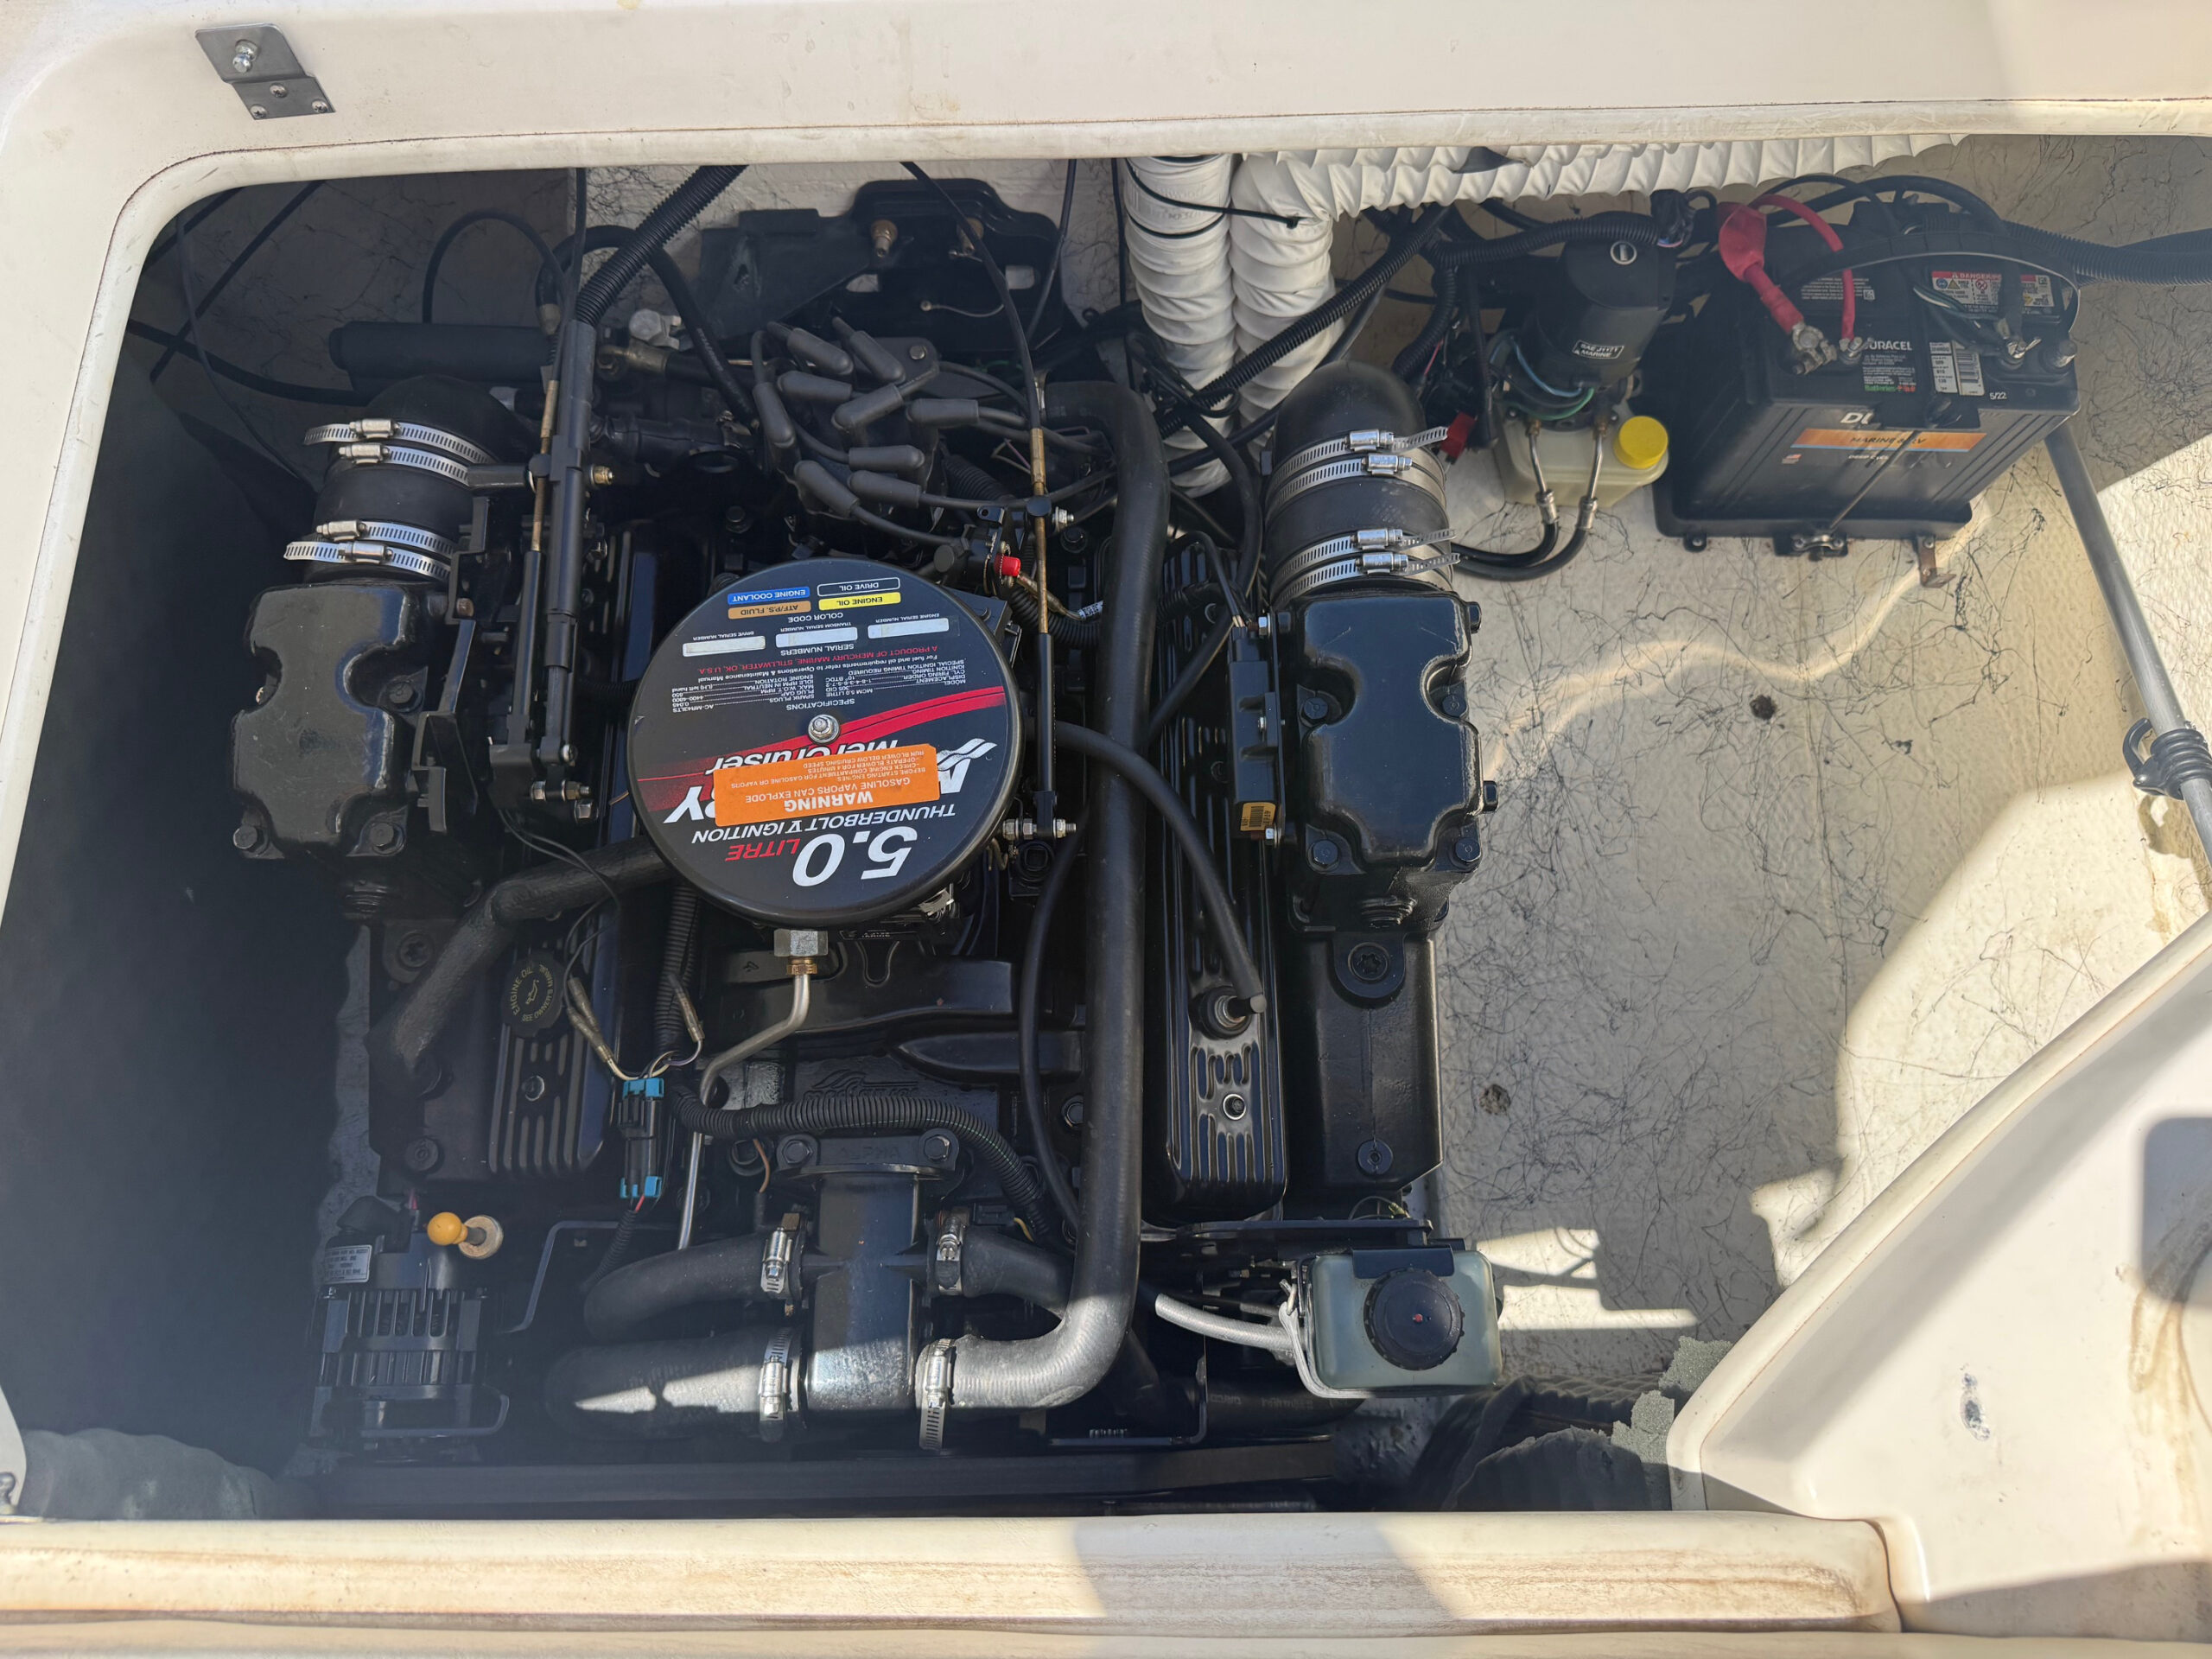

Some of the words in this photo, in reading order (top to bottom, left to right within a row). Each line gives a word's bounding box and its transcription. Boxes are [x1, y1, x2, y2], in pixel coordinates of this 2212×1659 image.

[733, 593, 772, 602] COOLANT
[774, 589, 805, 601] ENGINE
[780, 646, 823, 656] NUMBERS
[833, 652, 874, 661] MERCURY
[890, 646, 930, 656] PRODUCT
[842, 659, 887, 668] requirements
[916, 674, 965, 683] DISPLACEMENT
[786, 698, 855, 710] SPECIFICATIONS
[818, 768, 867, 778] COMPARTMENT
[817, 783, 857, 794] VAPORS
[861, 778, 910, 790] GASOLINE
[746, 791, 791, 803] EXPLODE
[794, 788, 814, 797] CAN
[785, 791, 873, 812] WARNING
[805, 804, 956, 831] THUNDERBOLT
[691, 822, 785, 843] IGNITION
[785, 820, 802, 834] V
[725, 838, 800, 861] LITRE
[792, 826, 918, 887] 5.0
[510, 976, 523, 1016] ENGINE
[521, 967, 533, 978] OIL
